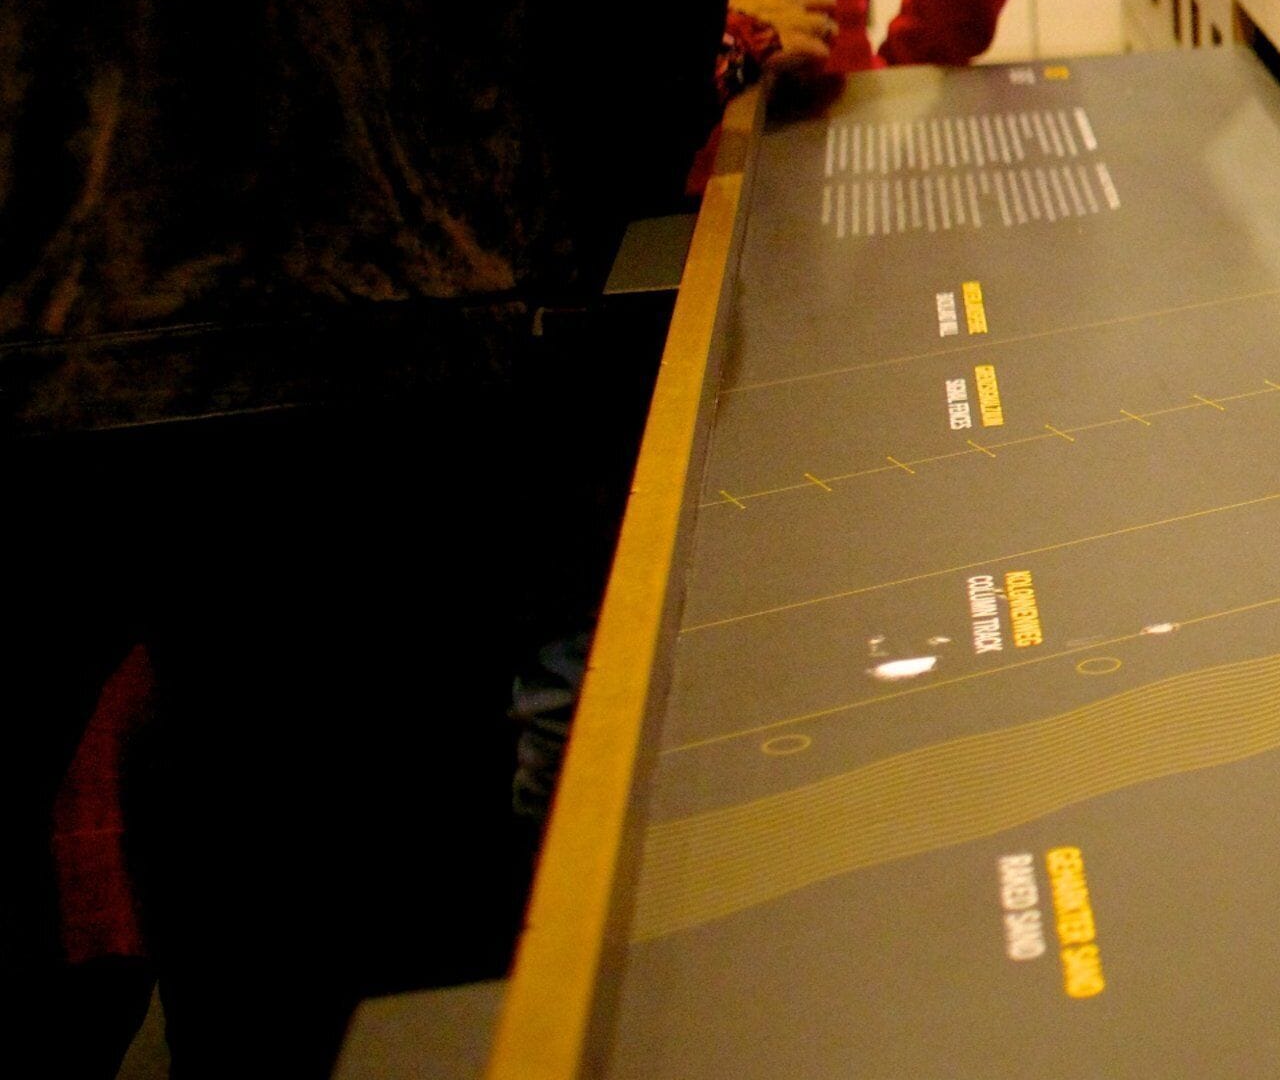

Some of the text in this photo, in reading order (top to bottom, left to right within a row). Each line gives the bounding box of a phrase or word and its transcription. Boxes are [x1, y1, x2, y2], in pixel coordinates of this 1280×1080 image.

[967, 574, 1004, 654] COLUMN TRACK
[1004, 570, 1043, 649] KOLONNENWEG
[999, 853, 1047, 961] RAKED SAND
[1060, 942, 1106, 999] SAND
